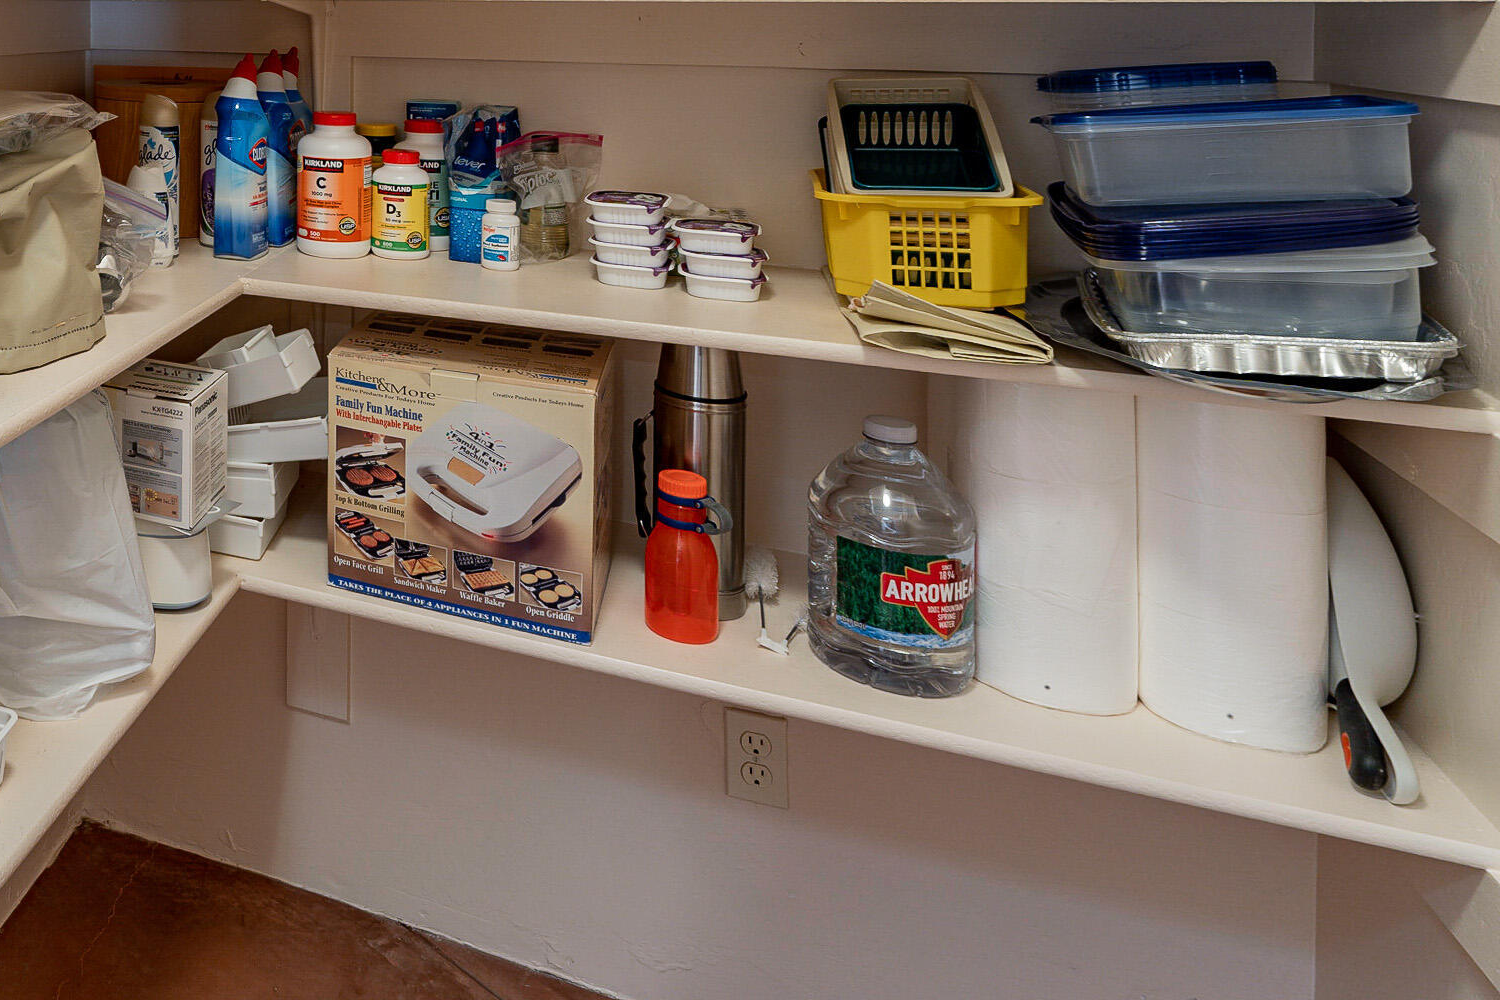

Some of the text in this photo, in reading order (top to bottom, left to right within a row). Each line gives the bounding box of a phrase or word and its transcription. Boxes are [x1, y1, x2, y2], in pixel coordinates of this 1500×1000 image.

[304, 158, 343, 169] KIRKLAND
[316, 176, 327, 189] C
[378, 184, 412, 193] KIRKLAND
[335, 384, 359, 394] Creative
[359, 389, 384, 399] Products
[396, 396, 417, 405] Todays
[417, 399, 436, 407] Home
[492, 391, 514, 399] Creative
[514, 393, 535, 402] Products
[548, 398, 567, 407] Todays
[567, 401, 585, 409] Home
[335, 394, 424, 422] Family Fun Machine
[335, 408, 423, 433] With Interchangable Plates
[451, 432, 505, 468] Family Fun
[458, 444, 490, 468] Machine
[334, 493, 405, 519] Top Bottom Grilling
[333, 554, 384, 575] Open Face Grill
[938, 569, 956, 581] 1894
[393, 576, 448, 596] Sandwich Maker
[884, 578, 976, 604] ARROWHEA
[459, 590, 506, 608] Waffle Baker
[337, 578, 578, 641] TAKES THE PLACE OF APPLIANCES IN FUN MACHINE
[525, 604, 575, 623] Open Griddle
[937, 612, 957, 622] SPRING
[940, 604, 965, 614] MOUNTAIN
[937, 620, 956, 629] WATER
